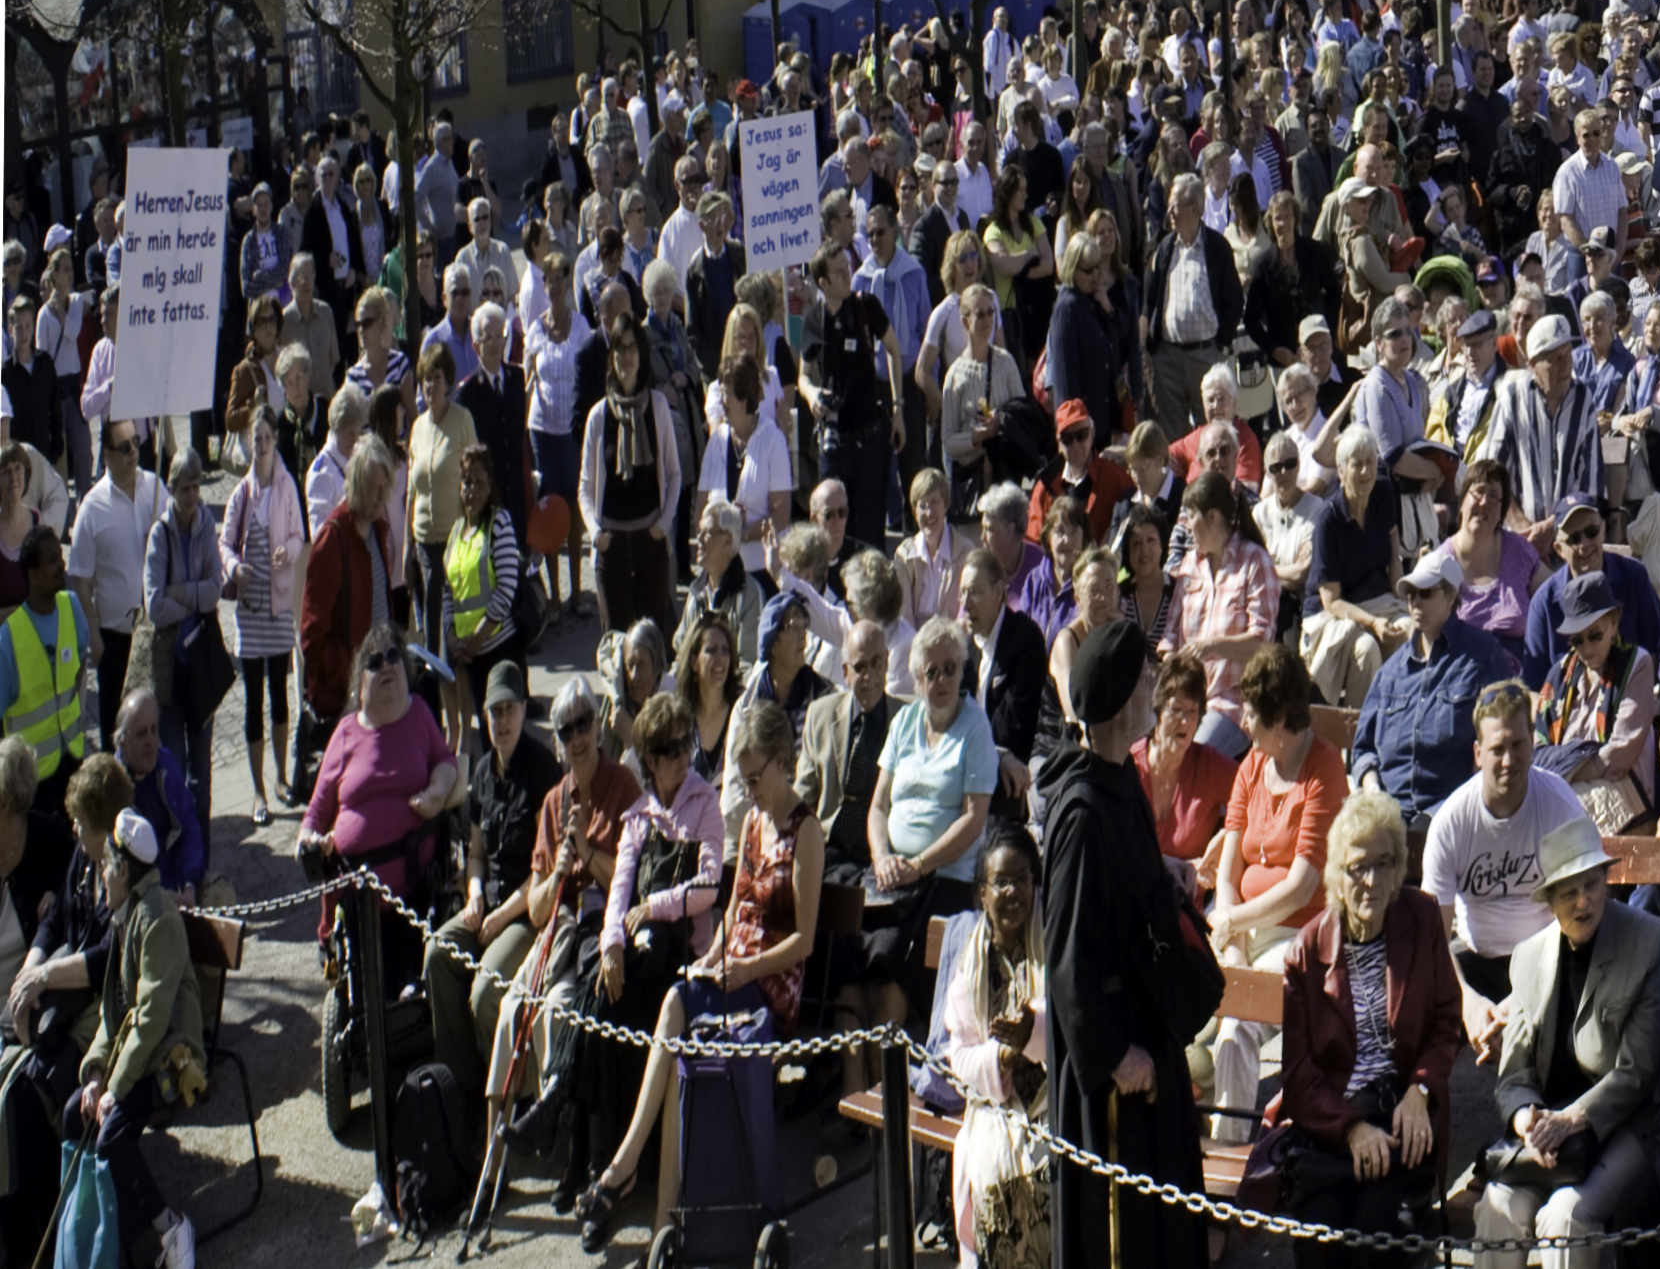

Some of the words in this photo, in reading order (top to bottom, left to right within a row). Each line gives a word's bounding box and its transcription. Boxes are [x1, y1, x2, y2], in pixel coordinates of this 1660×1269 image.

[746, 126, 783, 147] Jesus
[788, 122, 808, 137] sa:
[756, 152, 781, 172] Jag
[786, 148, 801, 165] är
[761, 177, 799, 200] vägen
[751, 202, 814, 229] sanningen
[125, 231, 142, 253] är
[147, 229, 171, 252] min
[177, 225, 217, 251] herde
[752, 235, 776, 255] och
[780, 228, 814, 253] livet.
[142, 265, 167, 294] mig
[172, 261, 203, 287] skall
[129, 304, 156, 327] inte
[162, 300, 210, 325] fattas.
